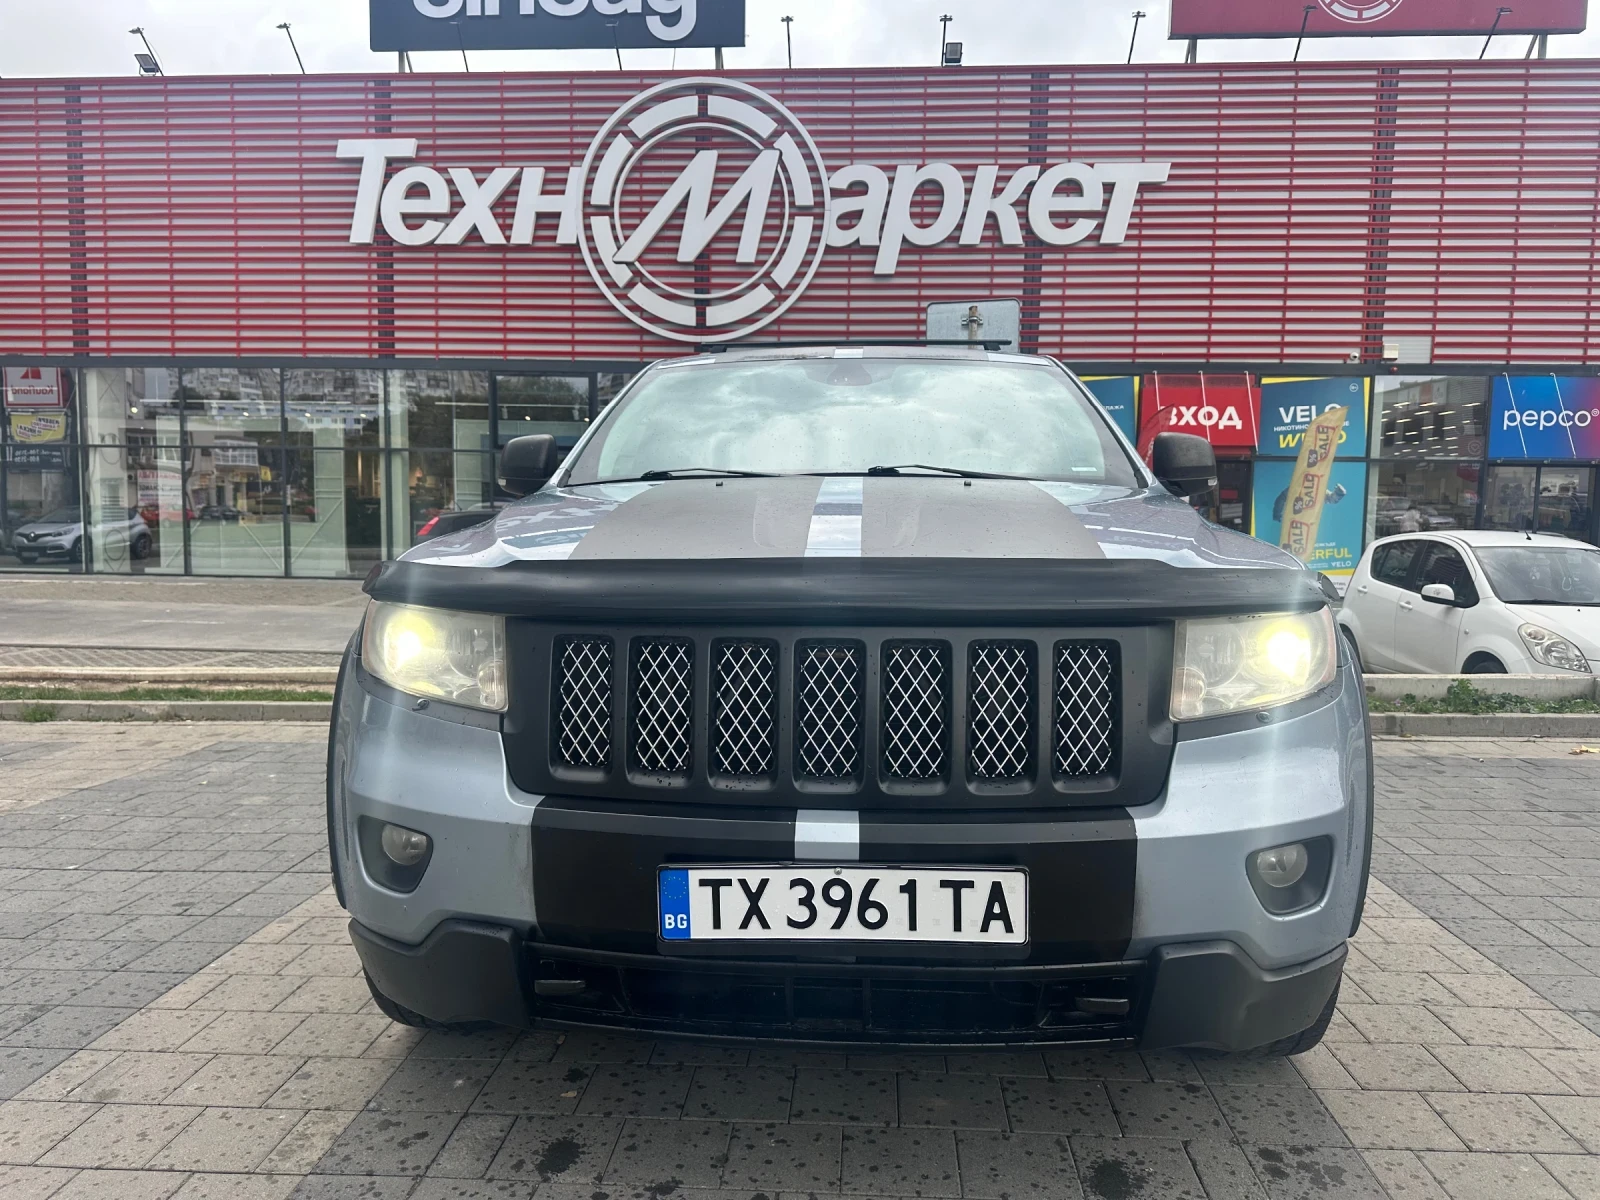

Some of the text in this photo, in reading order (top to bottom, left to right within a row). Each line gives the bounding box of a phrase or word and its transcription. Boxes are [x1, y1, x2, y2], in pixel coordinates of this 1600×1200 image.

[1318, 425, 1330, 459] SALE
[1305, 474, 1315, 507] SALE
[1291, 521, 1304, 553] SALE
[664, 913, 688, 929] BG
[699, 877, 1015, 933] TX 3961 TA
